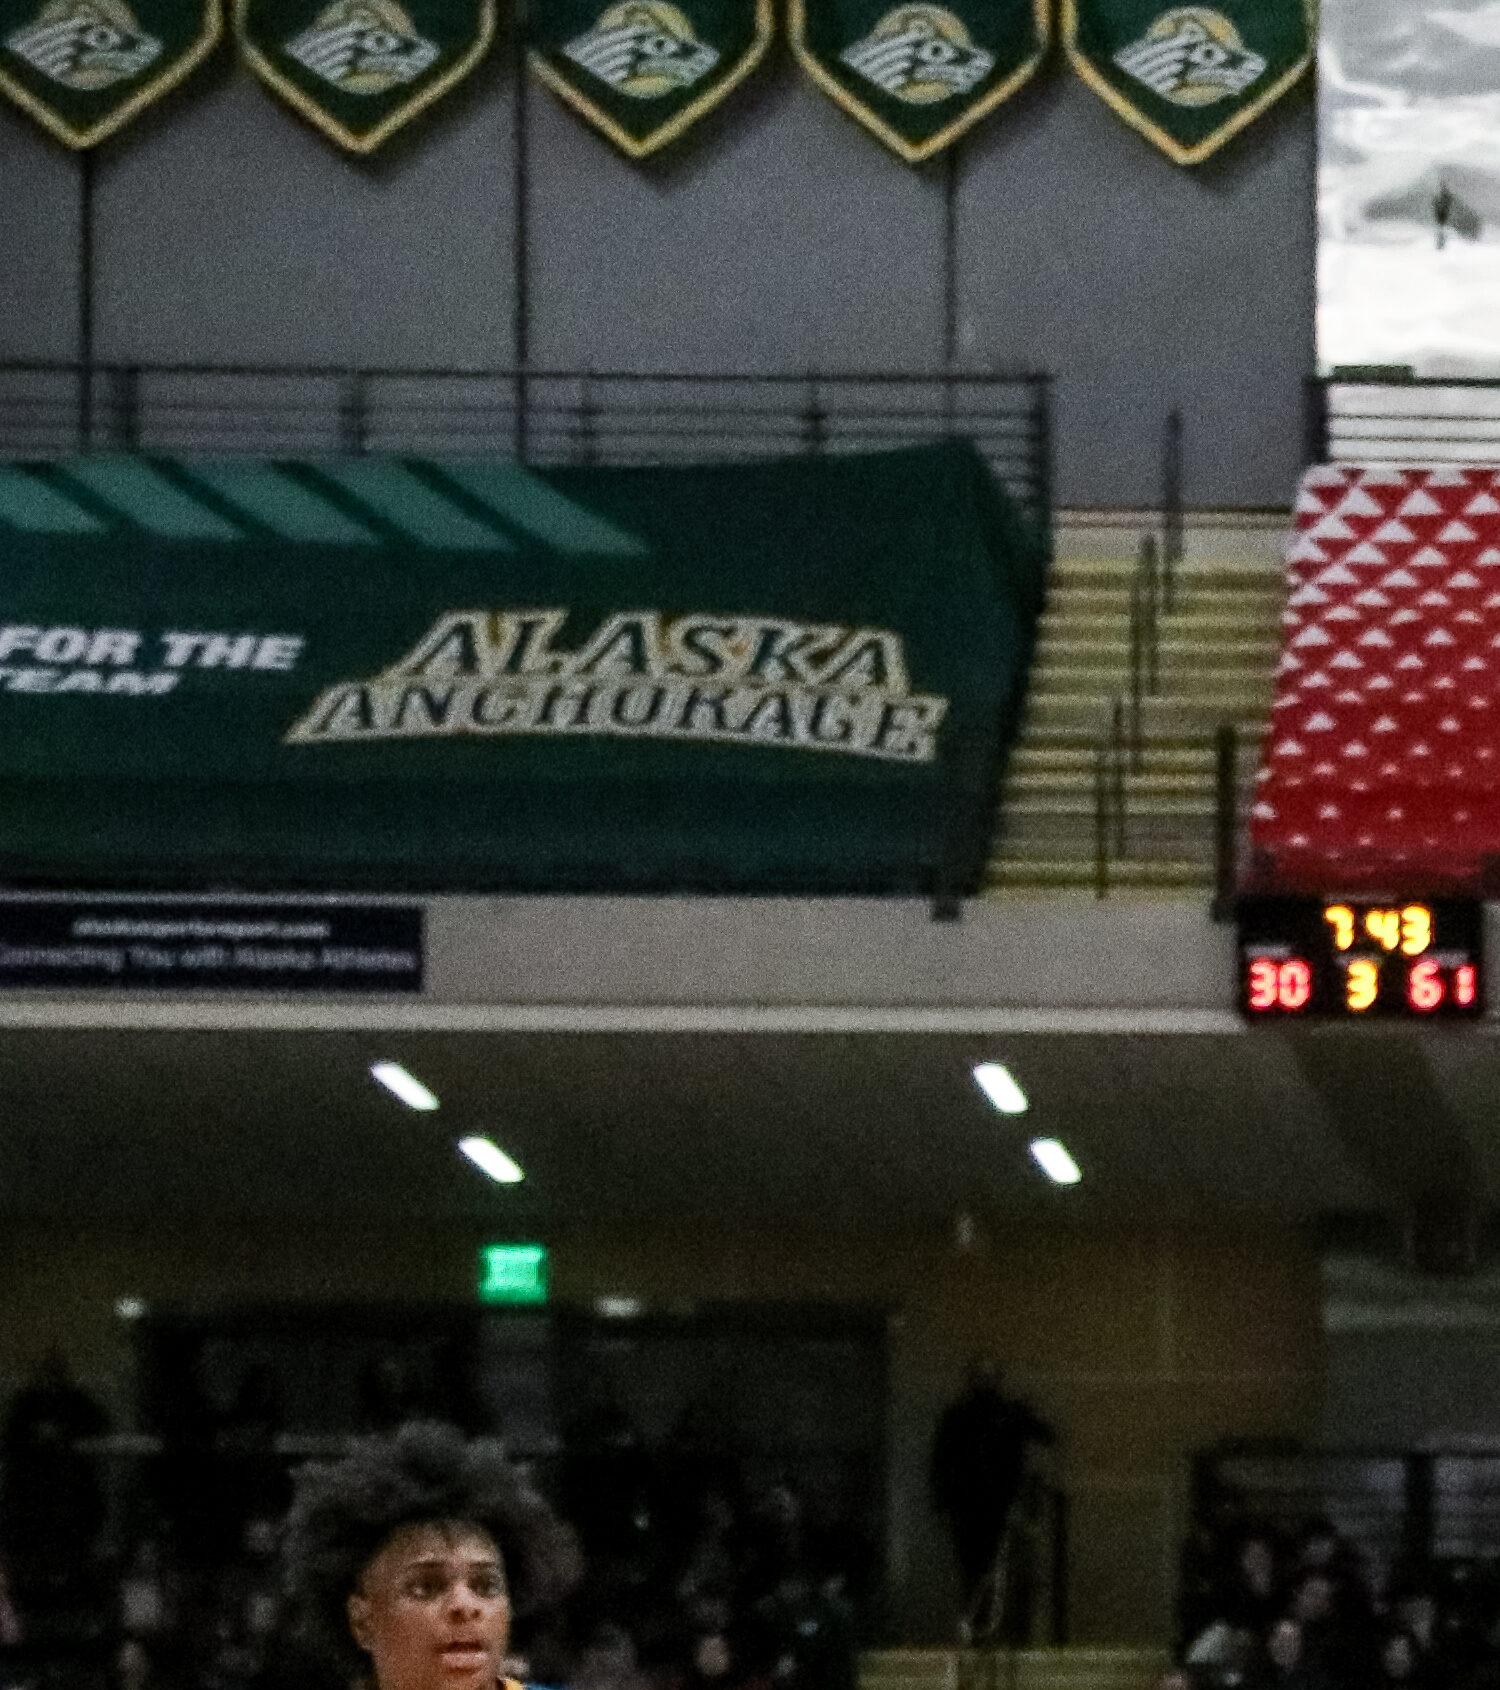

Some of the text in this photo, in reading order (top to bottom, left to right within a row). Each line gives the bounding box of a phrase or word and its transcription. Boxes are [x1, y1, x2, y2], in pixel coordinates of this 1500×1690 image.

[160, 631, 305, 670] THE
[400, 610, 907, 692] ALASKA
[290, 682, 943, 761] ANCHORAGE
[1249, 957, 1312, 1010] 30
[1346, 958, 1380, 1011] 3
